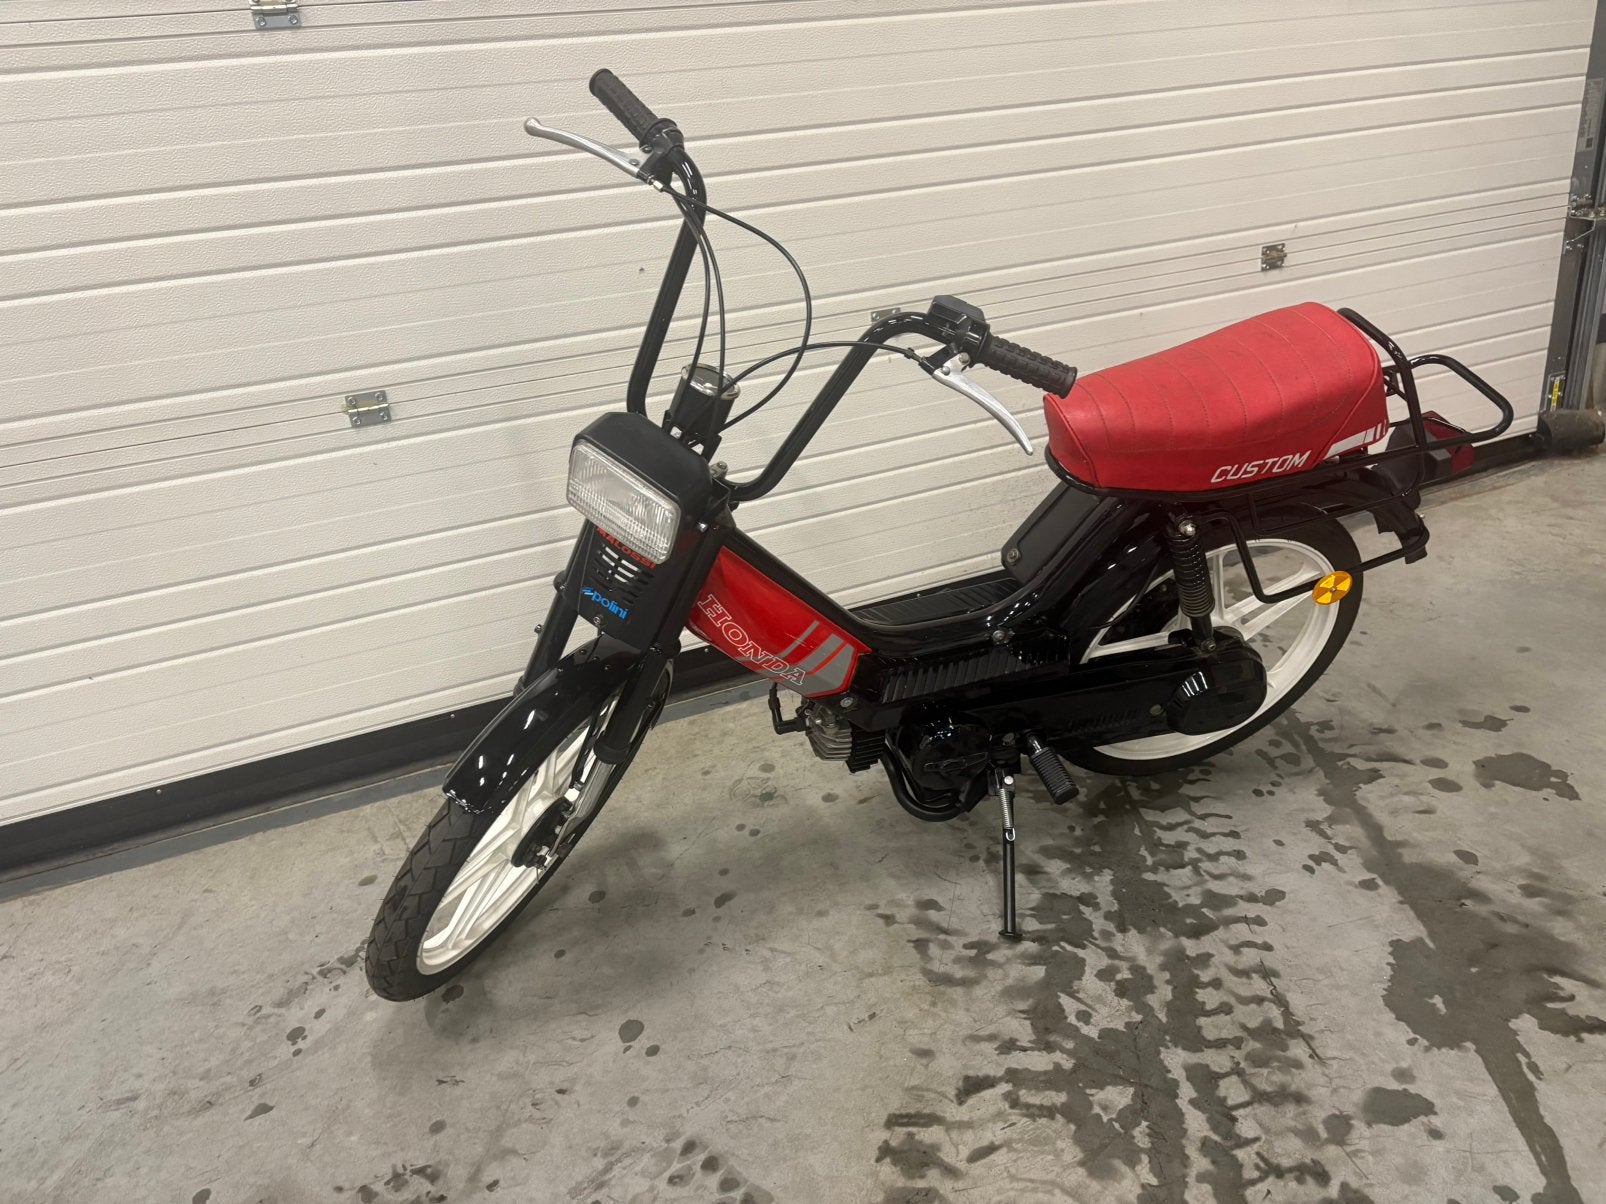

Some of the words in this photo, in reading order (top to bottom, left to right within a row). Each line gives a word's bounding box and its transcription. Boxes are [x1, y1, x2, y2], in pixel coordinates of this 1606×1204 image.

[1211, 450, 1312, 483] CUSTOM
[591, 590, 629, 619] polini
[697, 594, 806, 685] HONDA
